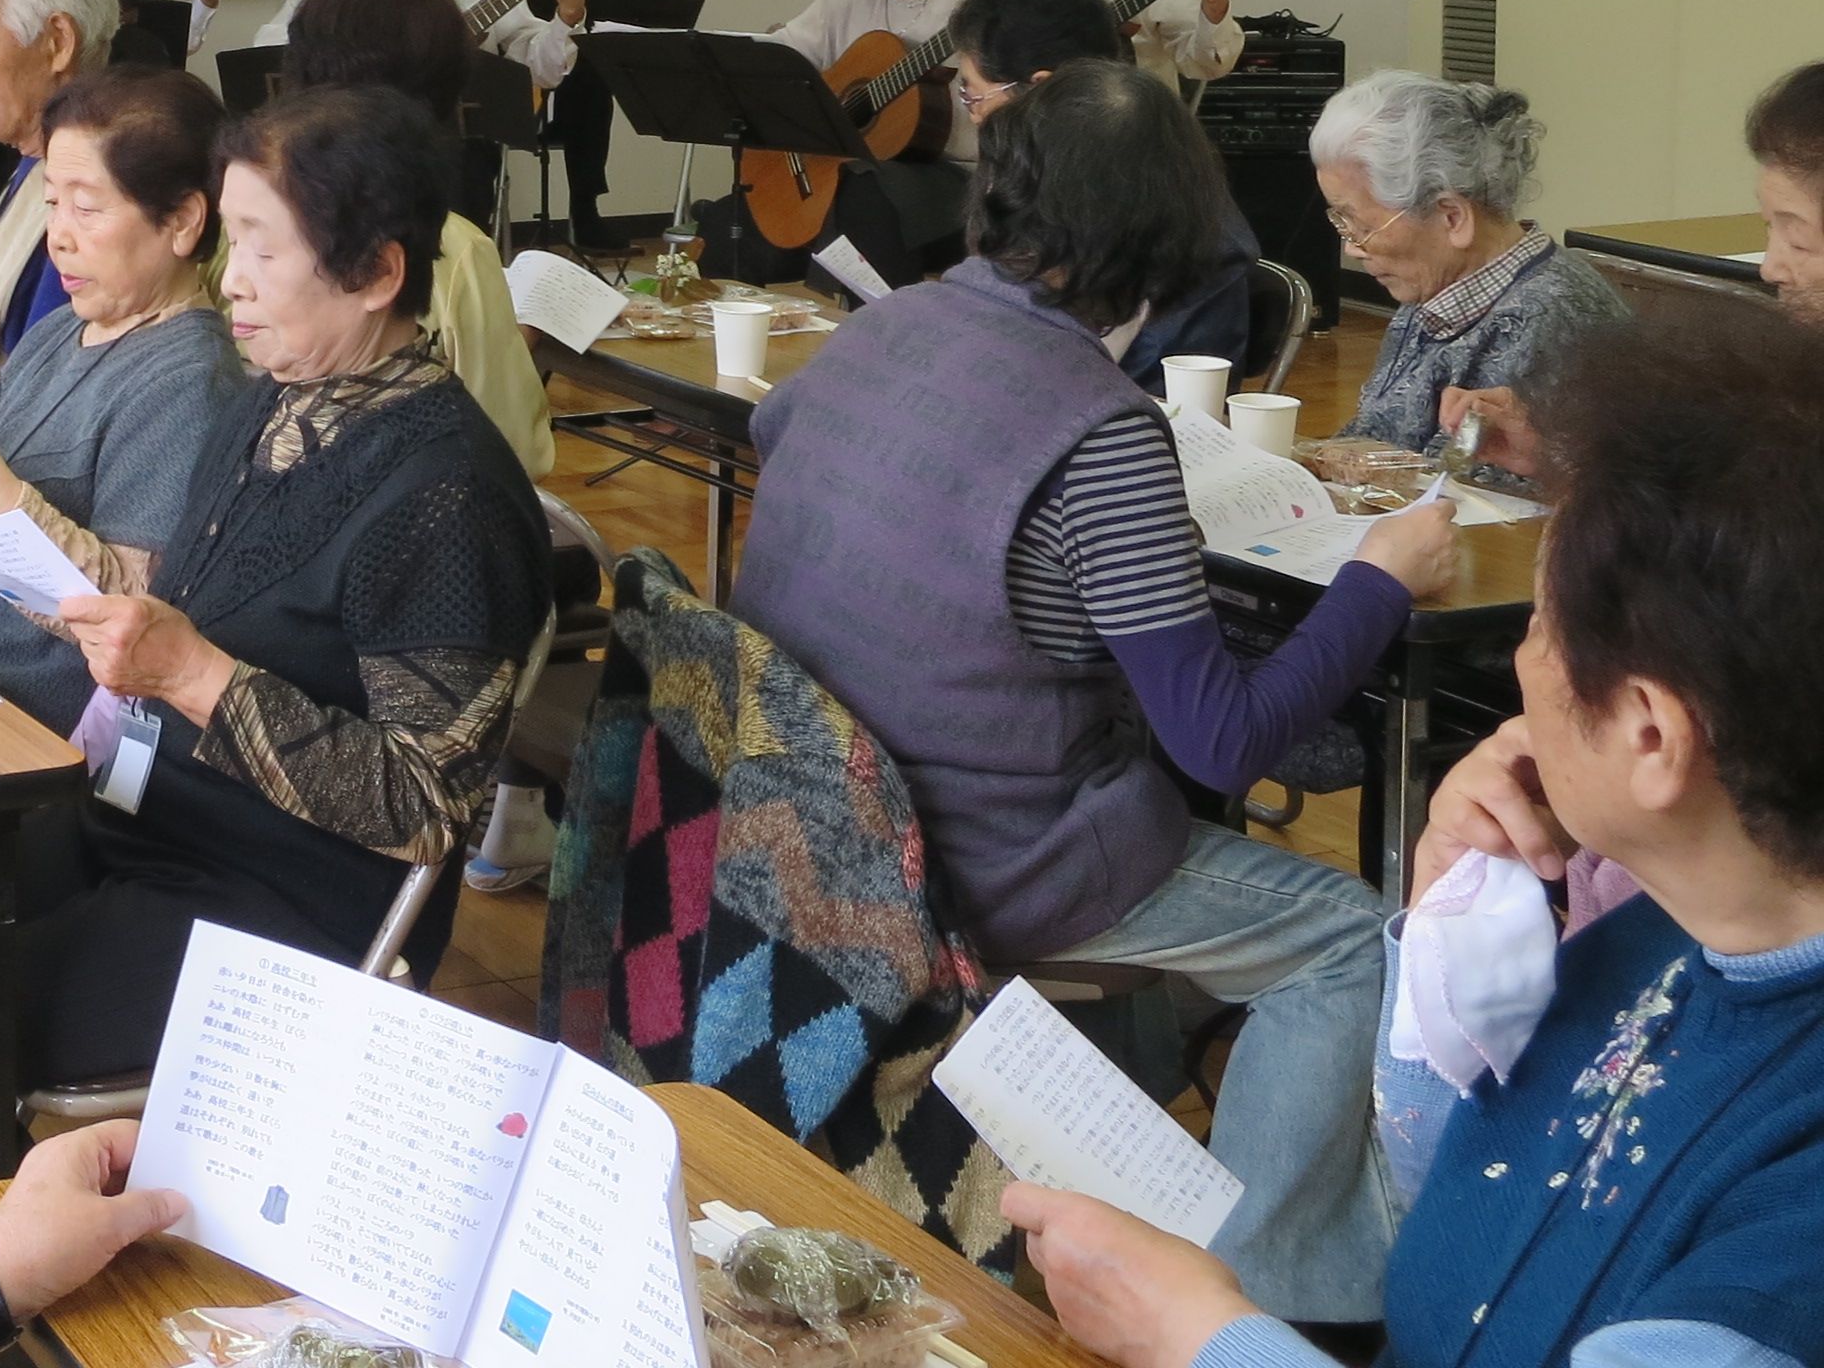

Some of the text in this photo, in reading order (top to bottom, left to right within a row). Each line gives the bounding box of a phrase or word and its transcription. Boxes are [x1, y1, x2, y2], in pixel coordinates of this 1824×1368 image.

[232, 1006, 279, 1030] 高校三年生
[208, 1095, 255, 1120] 高校三年生
